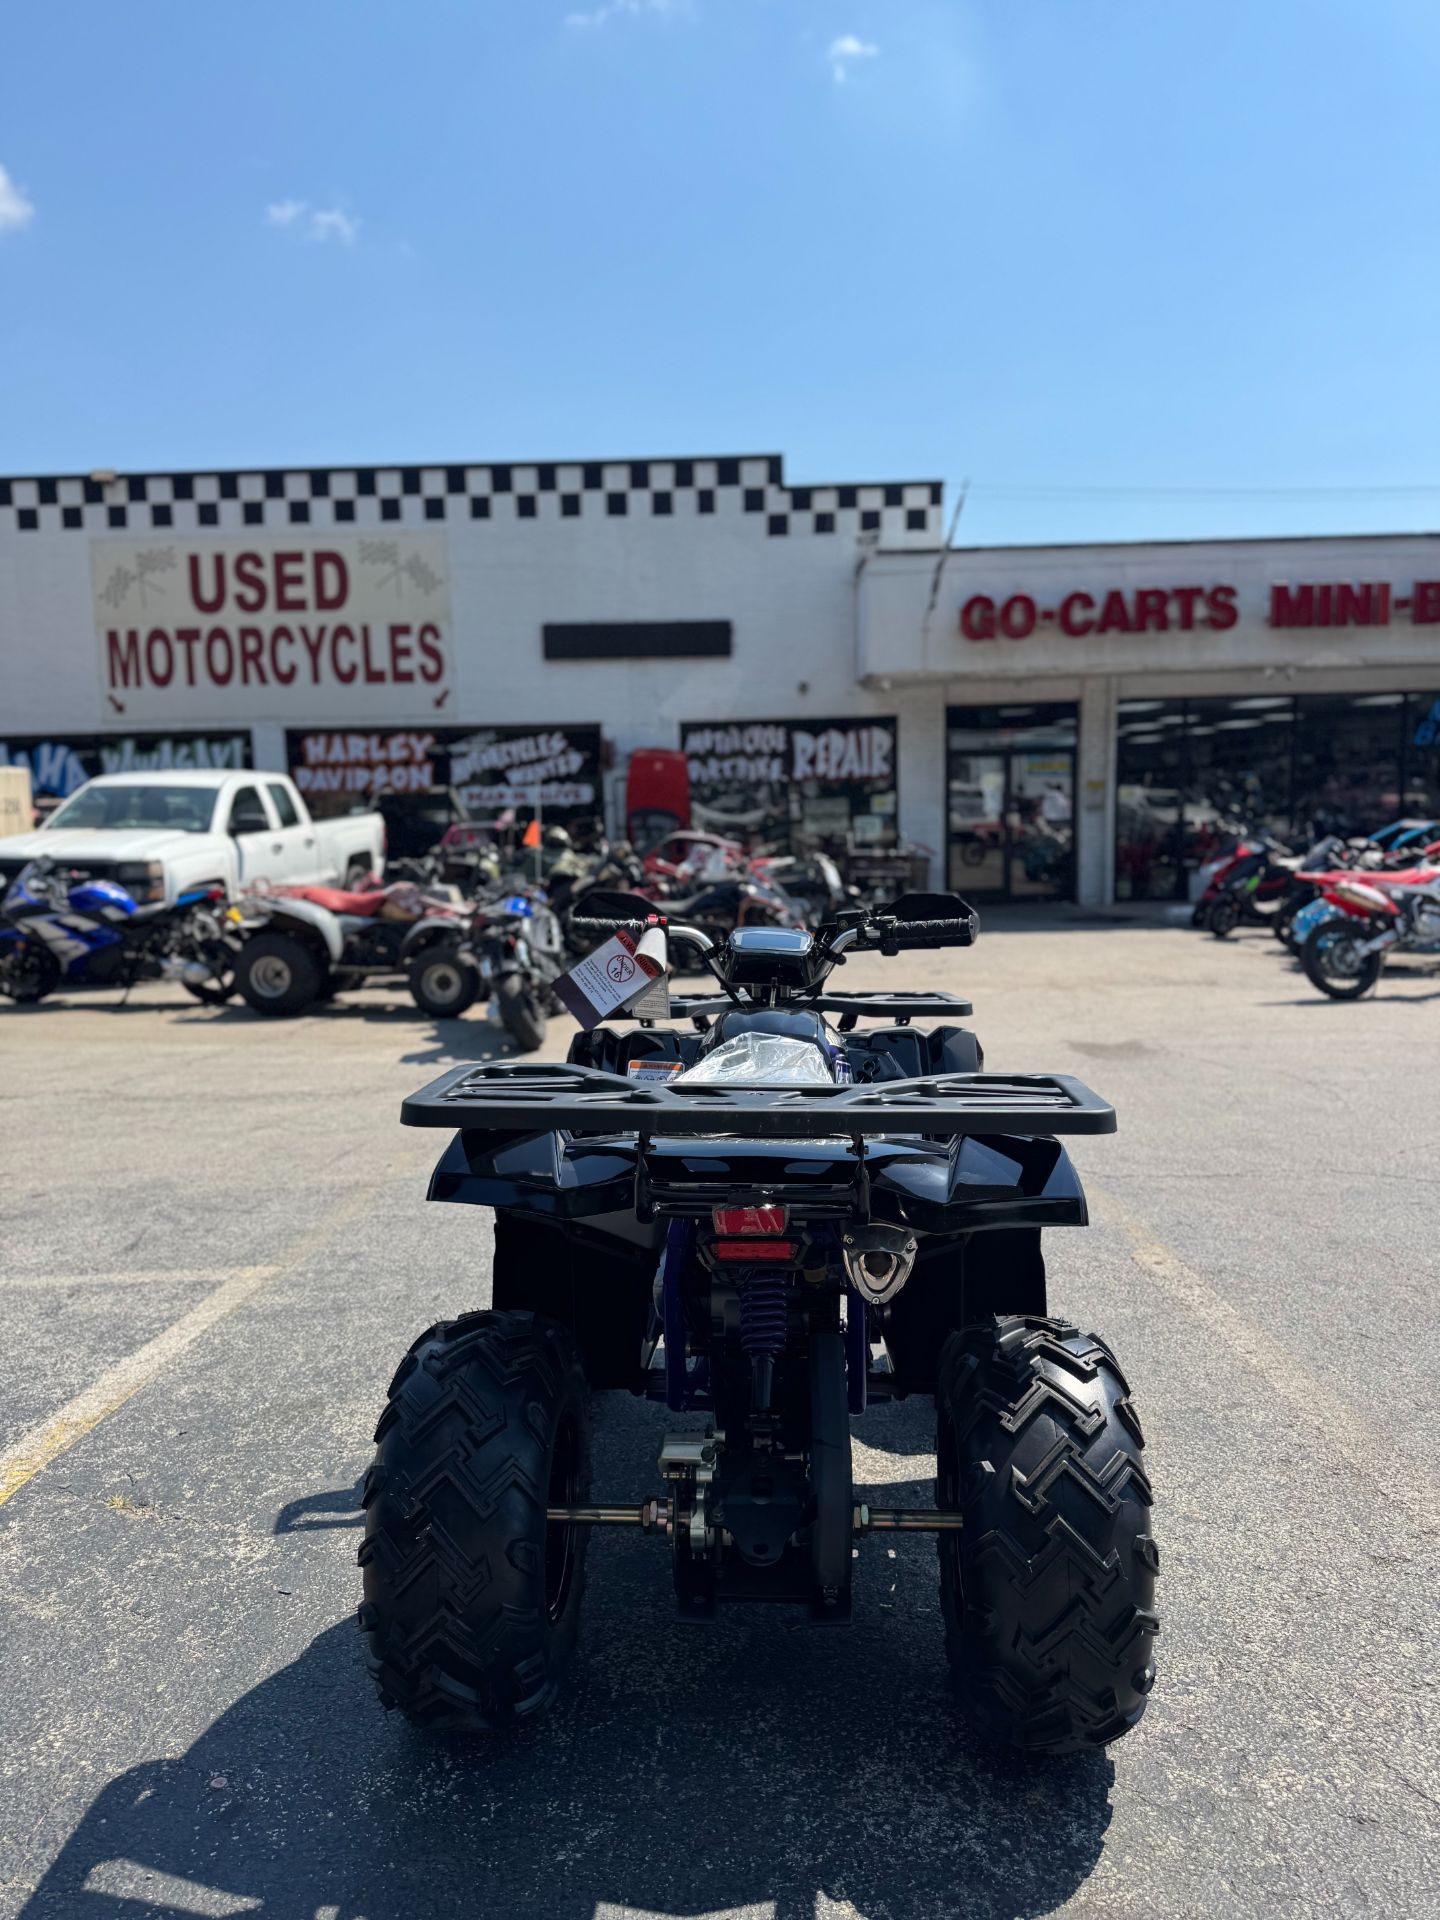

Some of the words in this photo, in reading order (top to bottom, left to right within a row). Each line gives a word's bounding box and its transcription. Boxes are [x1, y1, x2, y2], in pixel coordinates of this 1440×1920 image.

[189, 551, 349, 613] USED
[961, 586, 1238, 640] GO-CARTS
[107, 624, 443, 687] MOTORCYCLES
[303, 733, 434, 764] HARLEY
[792, 726, 893, 780] REPAIR
[294, 763, 434, 790] DAVIDSON
[610, 966, 622, 979] 16
[615, 955, 633, 975] UNDER
